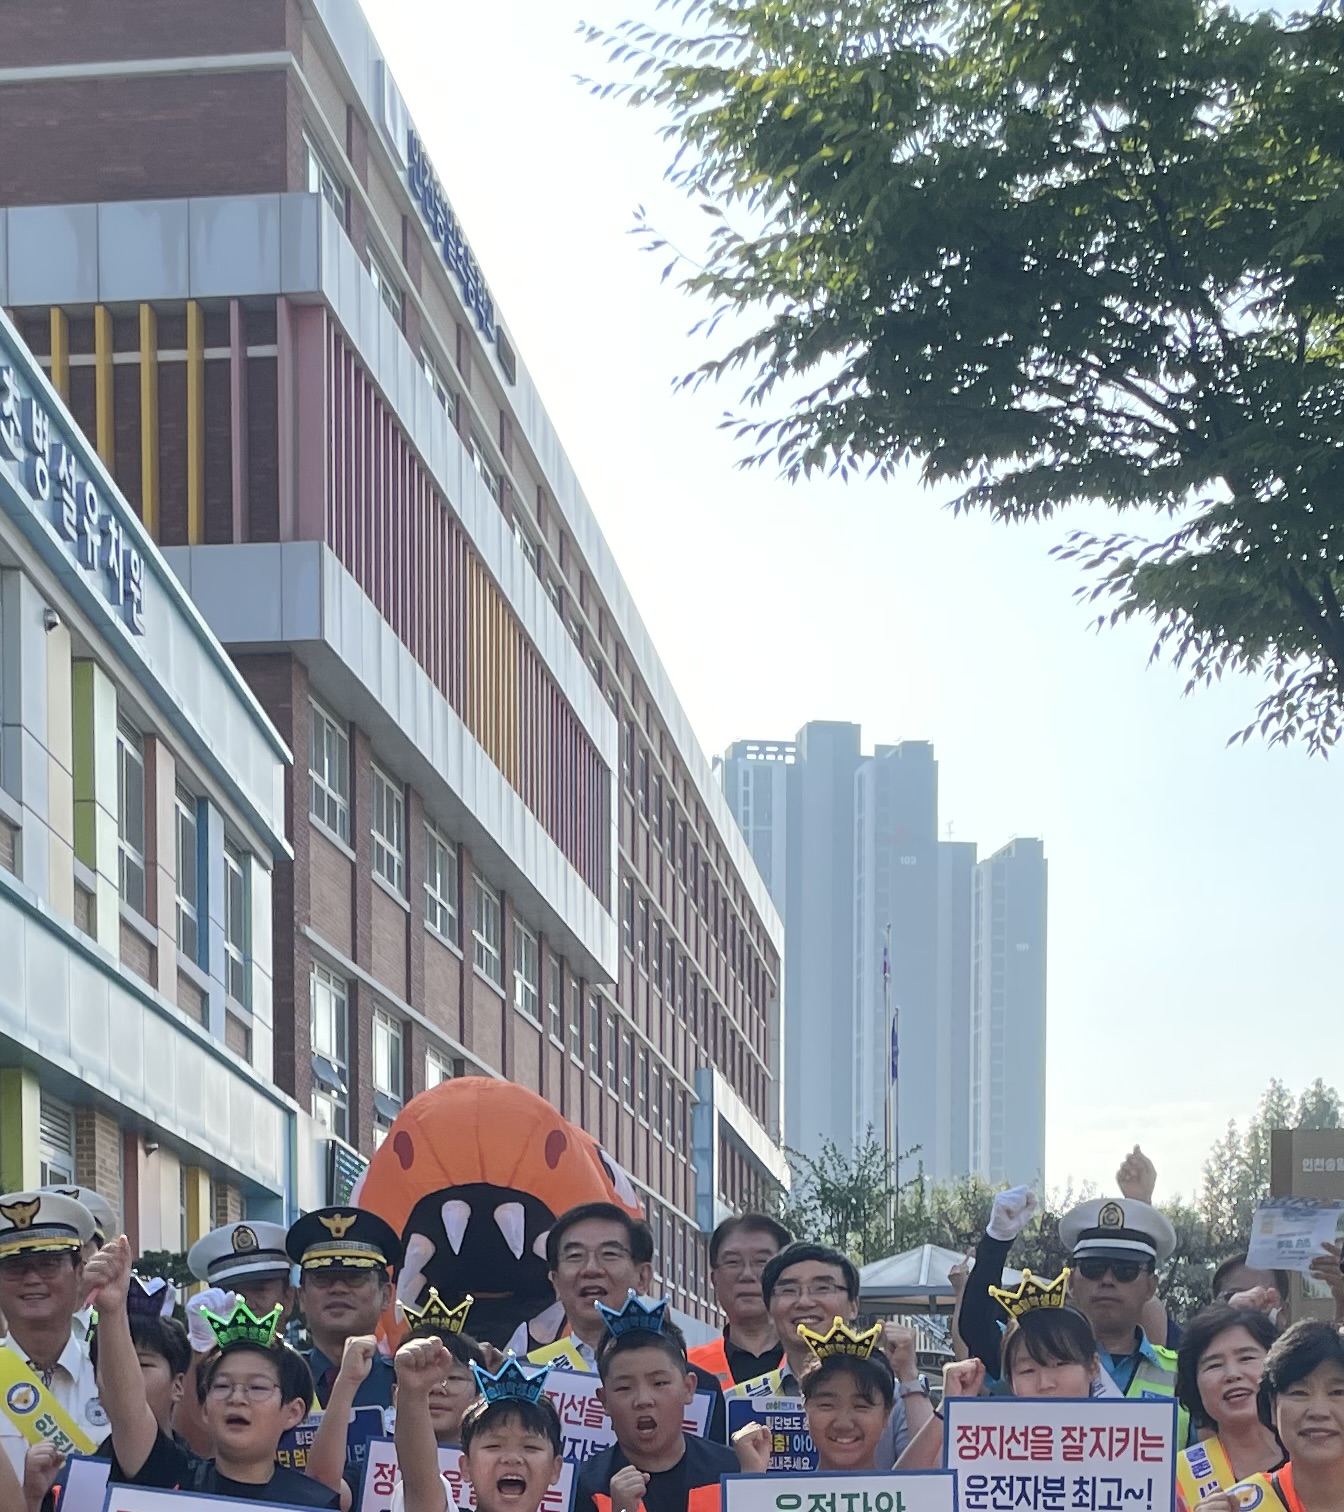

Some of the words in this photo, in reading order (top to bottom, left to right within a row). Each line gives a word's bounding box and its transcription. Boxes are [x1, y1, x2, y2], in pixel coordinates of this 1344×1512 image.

[956, 1425, 1054, 1462] 정지선을
[964, 1474, 1066, 1512] 운전자분
[1071, 1475, 1153, 1512] 최고~!
